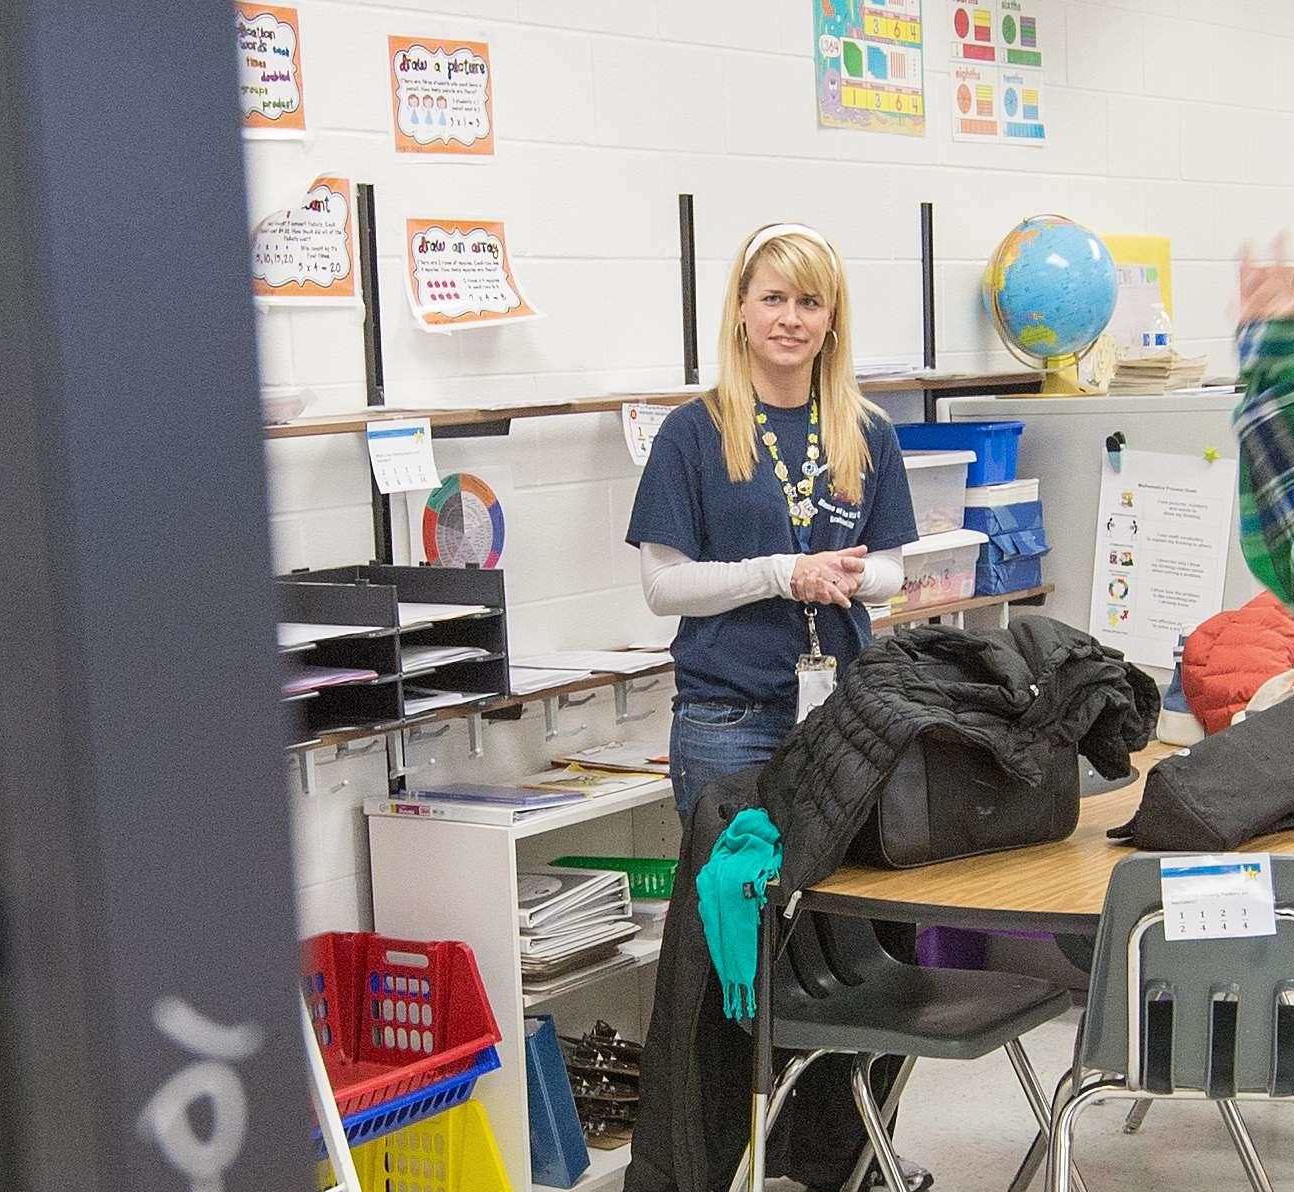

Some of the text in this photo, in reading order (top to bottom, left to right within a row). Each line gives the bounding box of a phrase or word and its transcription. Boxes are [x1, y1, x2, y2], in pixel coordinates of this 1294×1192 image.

[894, 22, 901, 38] 6
[399, 54, 486, 80] draw a picture
[896, 95, 903, 111] 6
[418, 236, 500, 259] draw an array
[1219, 908, 1227, 917] 2
[1179, 924, 1186, 933] 2
